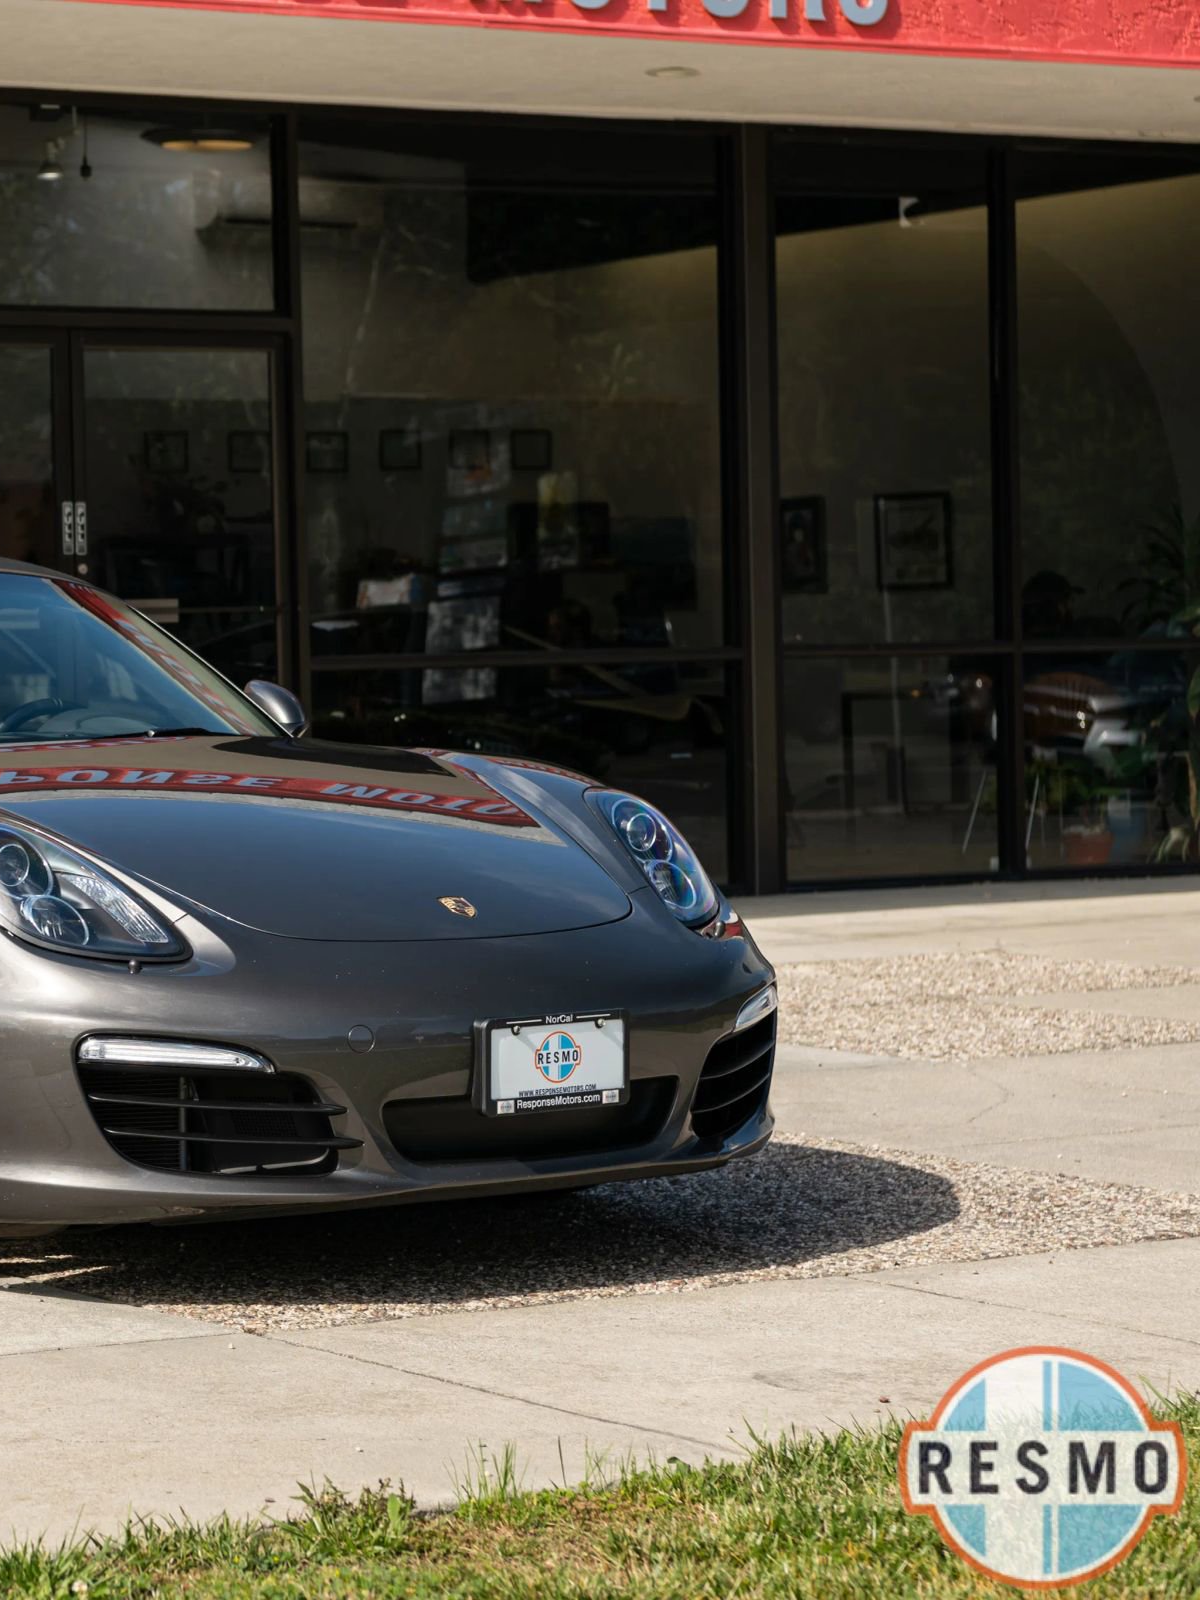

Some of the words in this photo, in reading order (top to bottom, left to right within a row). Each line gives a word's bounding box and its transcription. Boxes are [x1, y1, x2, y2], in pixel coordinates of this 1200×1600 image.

[545, 1014, 574, 1024] NorCal
[537, 1049, 579, 1065] RESMO
[519, 1084, 597, 1097] WWW.RESPONSEMOTORS.COM
[517, 1094, 601, 1110] ResponseMotors.com
